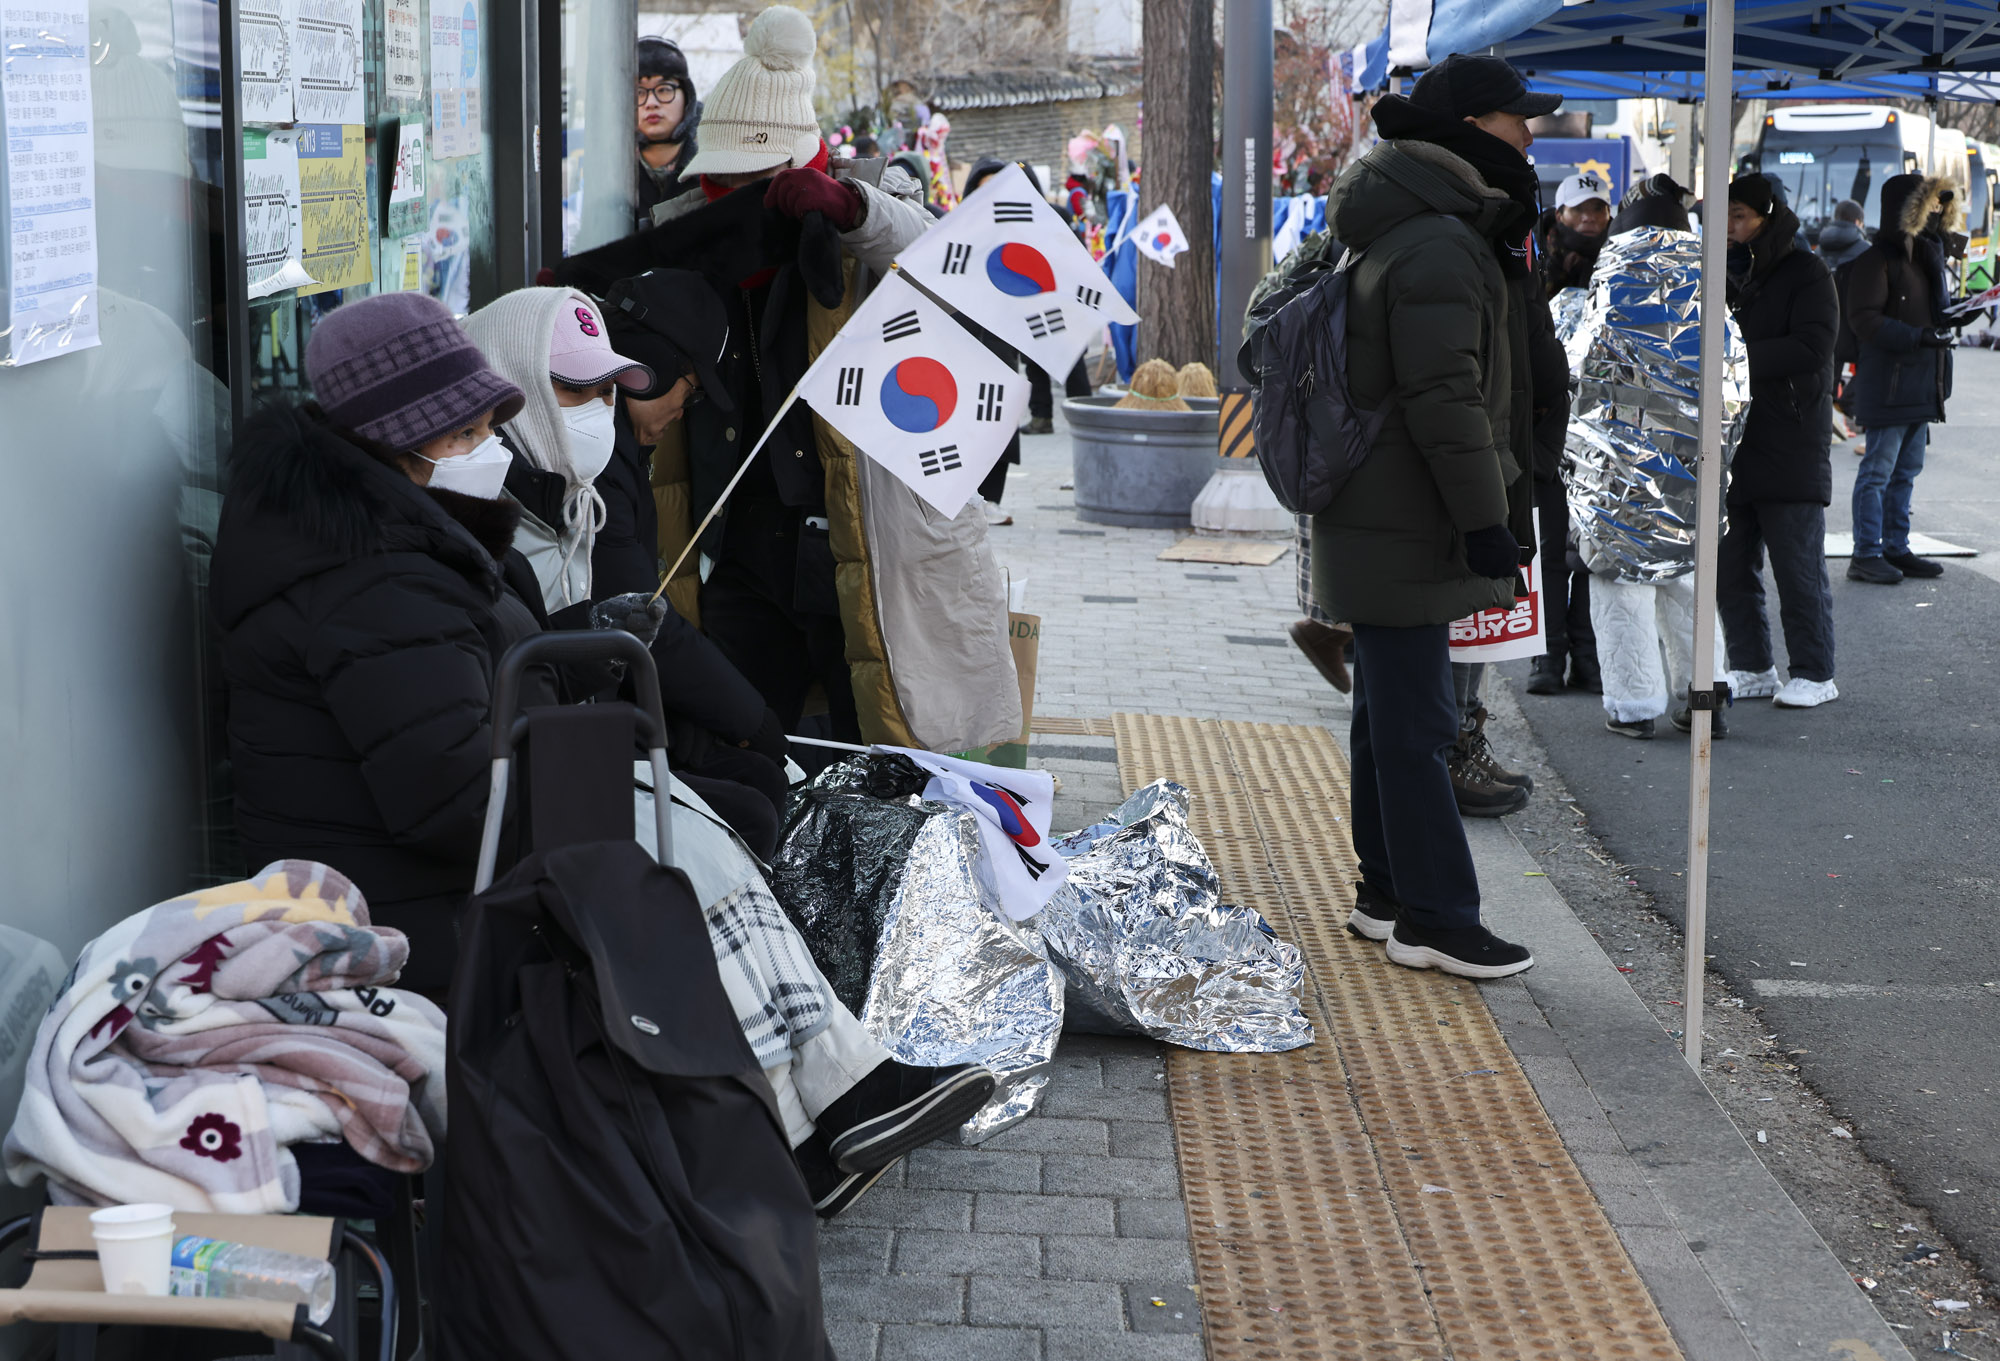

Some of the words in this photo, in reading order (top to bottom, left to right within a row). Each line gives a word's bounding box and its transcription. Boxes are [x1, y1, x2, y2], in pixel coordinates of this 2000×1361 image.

[304, 128, 316, 153] N13
[1578, 176, 1599, 192] NY
[575, 307, 599, 337] S
